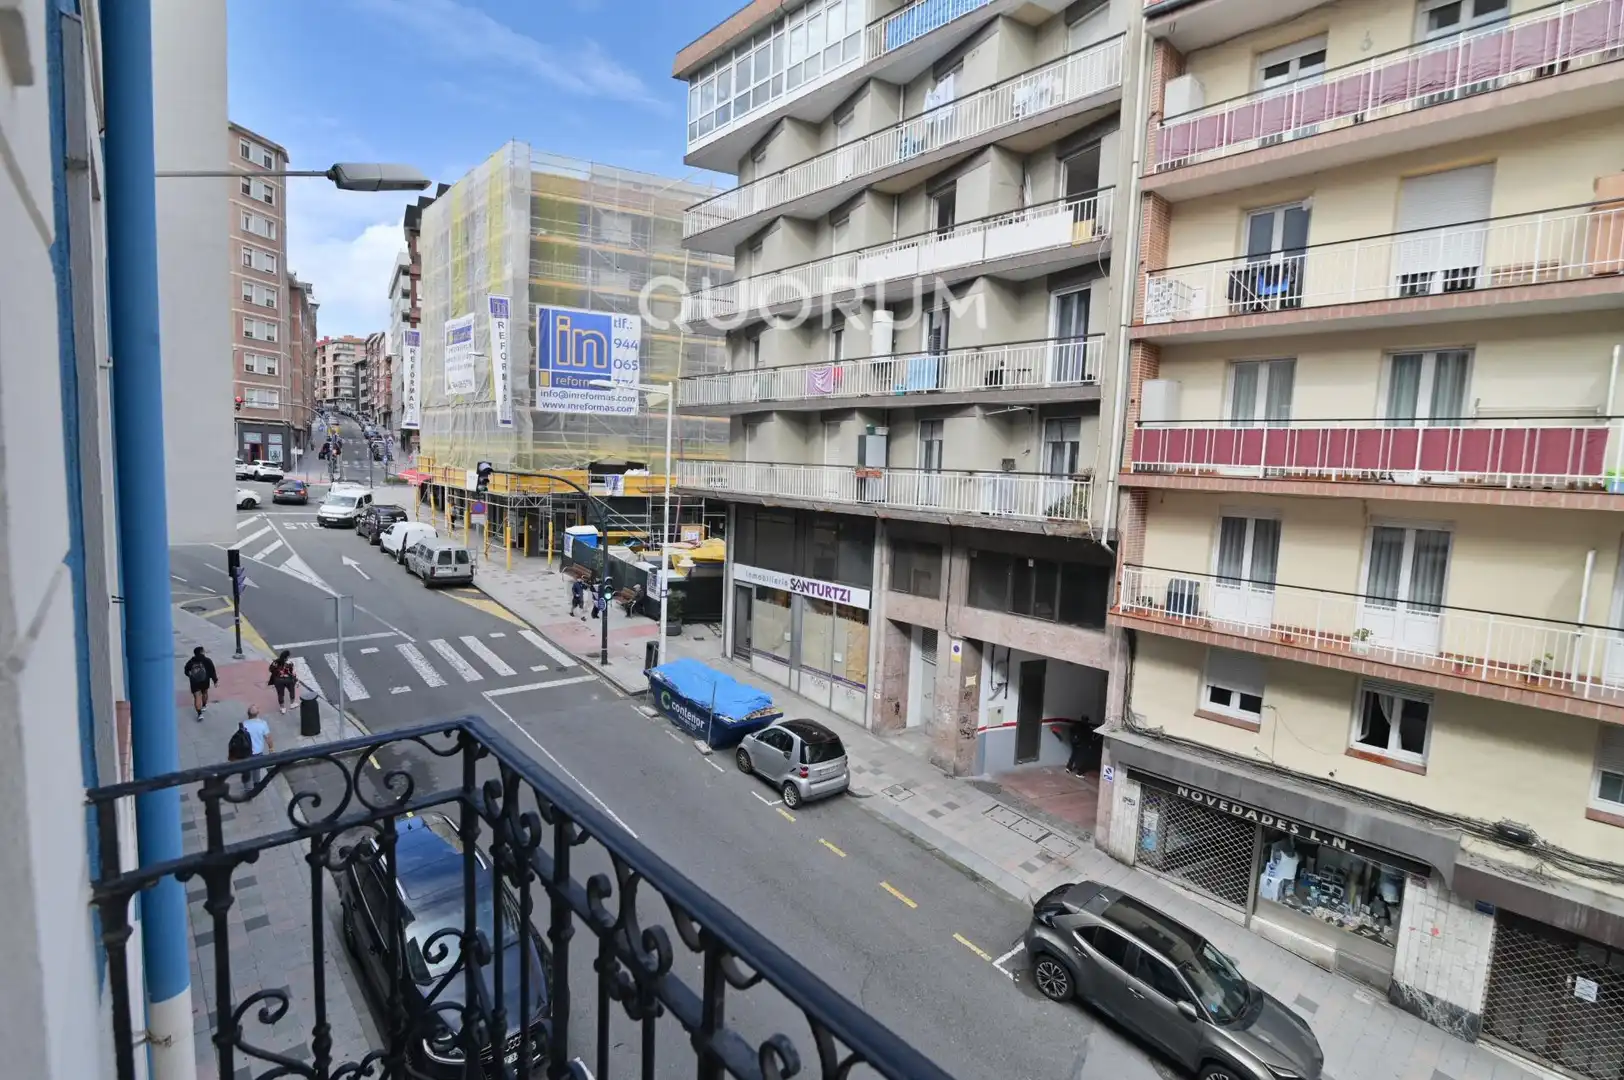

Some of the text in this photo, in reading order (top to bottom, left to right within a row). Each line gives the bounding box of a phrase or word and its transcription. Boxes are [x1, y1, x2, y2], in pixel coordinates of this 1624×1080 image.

[555, 315, 608, 369] in
[613, 338, 639, 350] 944
[497, 321, 508, 402] REFORMAS
[613, 358, 639, 371] 065
[282, 522, 325, 530] STO
[789, 578, 851, 603] SANTURTZI
[671, 701, 705, 729] contenor
[1177, 786, 1356, 853] NOVEDADES L.N.
